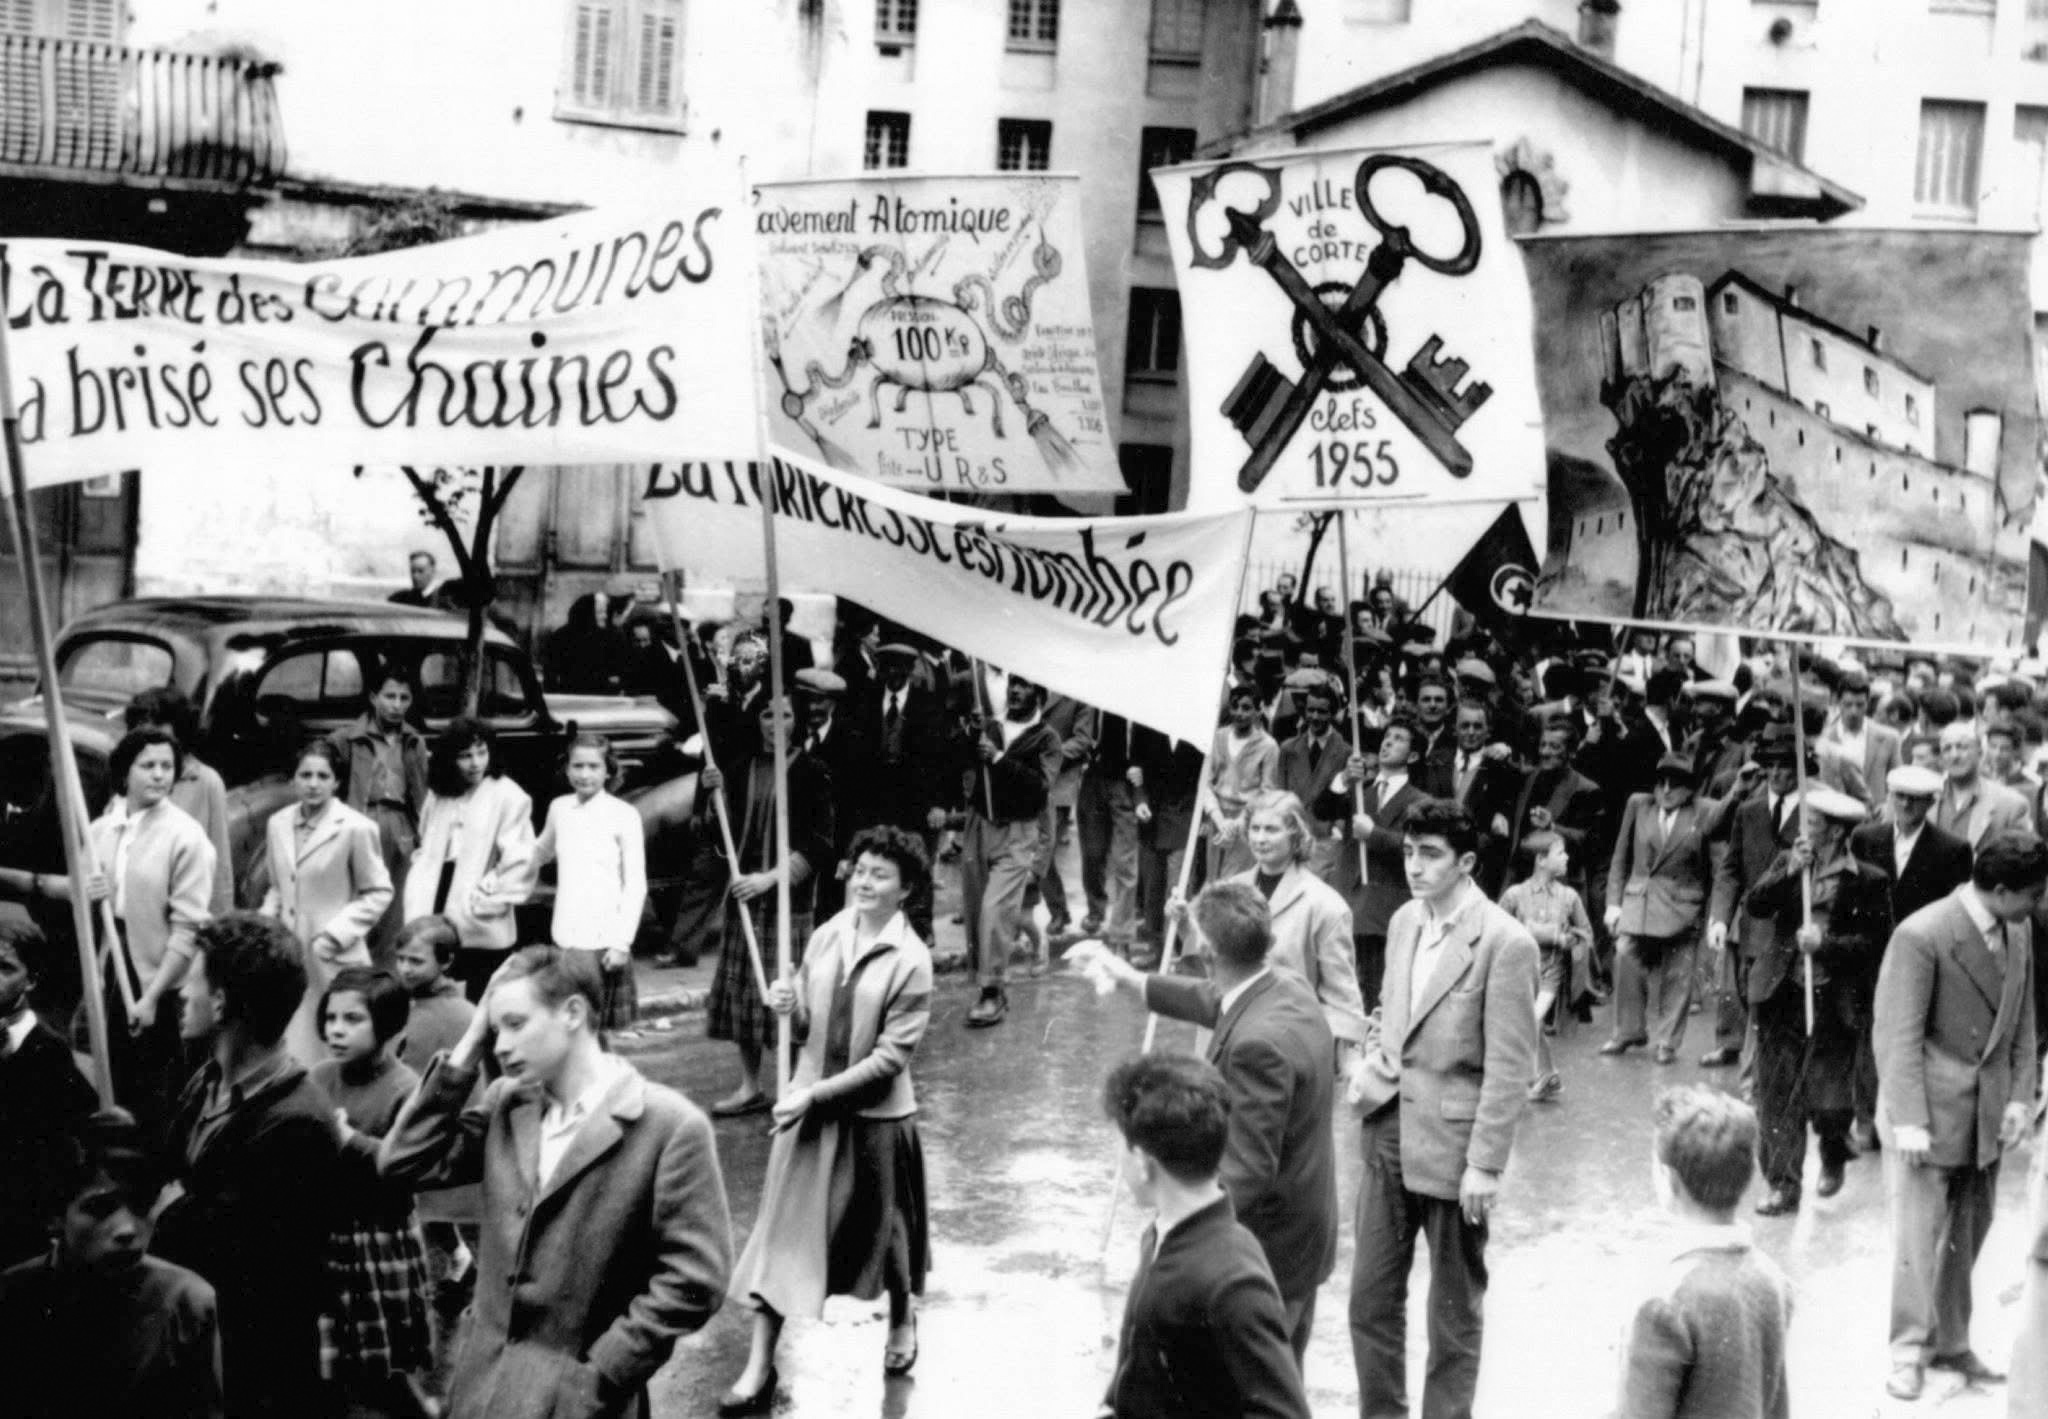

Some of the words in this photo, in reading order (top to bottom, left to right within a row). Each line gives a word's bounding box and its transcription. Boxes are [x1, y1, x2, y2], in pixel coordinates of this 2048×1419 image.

[752, 188, 857, 234] avement
[868, 194, 1010, 245] Atomique
[1288, 178, 1352, 217] VILLE
[1307, 219, 1337, 239] de
[1294, 241, 1367, 267] CORTE
[0, 244, 69, 330] La
[65, 250, 205, 324] TERRE
[217, 273, 293, 324] des
[892, 326, 941, 361] 100
[19, 376, 46, 444] a
[67, 340, 218, 437] brisé
[239, 358, 322, 428] ses
[350, 324, 678, 429] Chaines
[896, 427, 957, 452] TYPE
[1307, 440, 1399, 488] 1955
